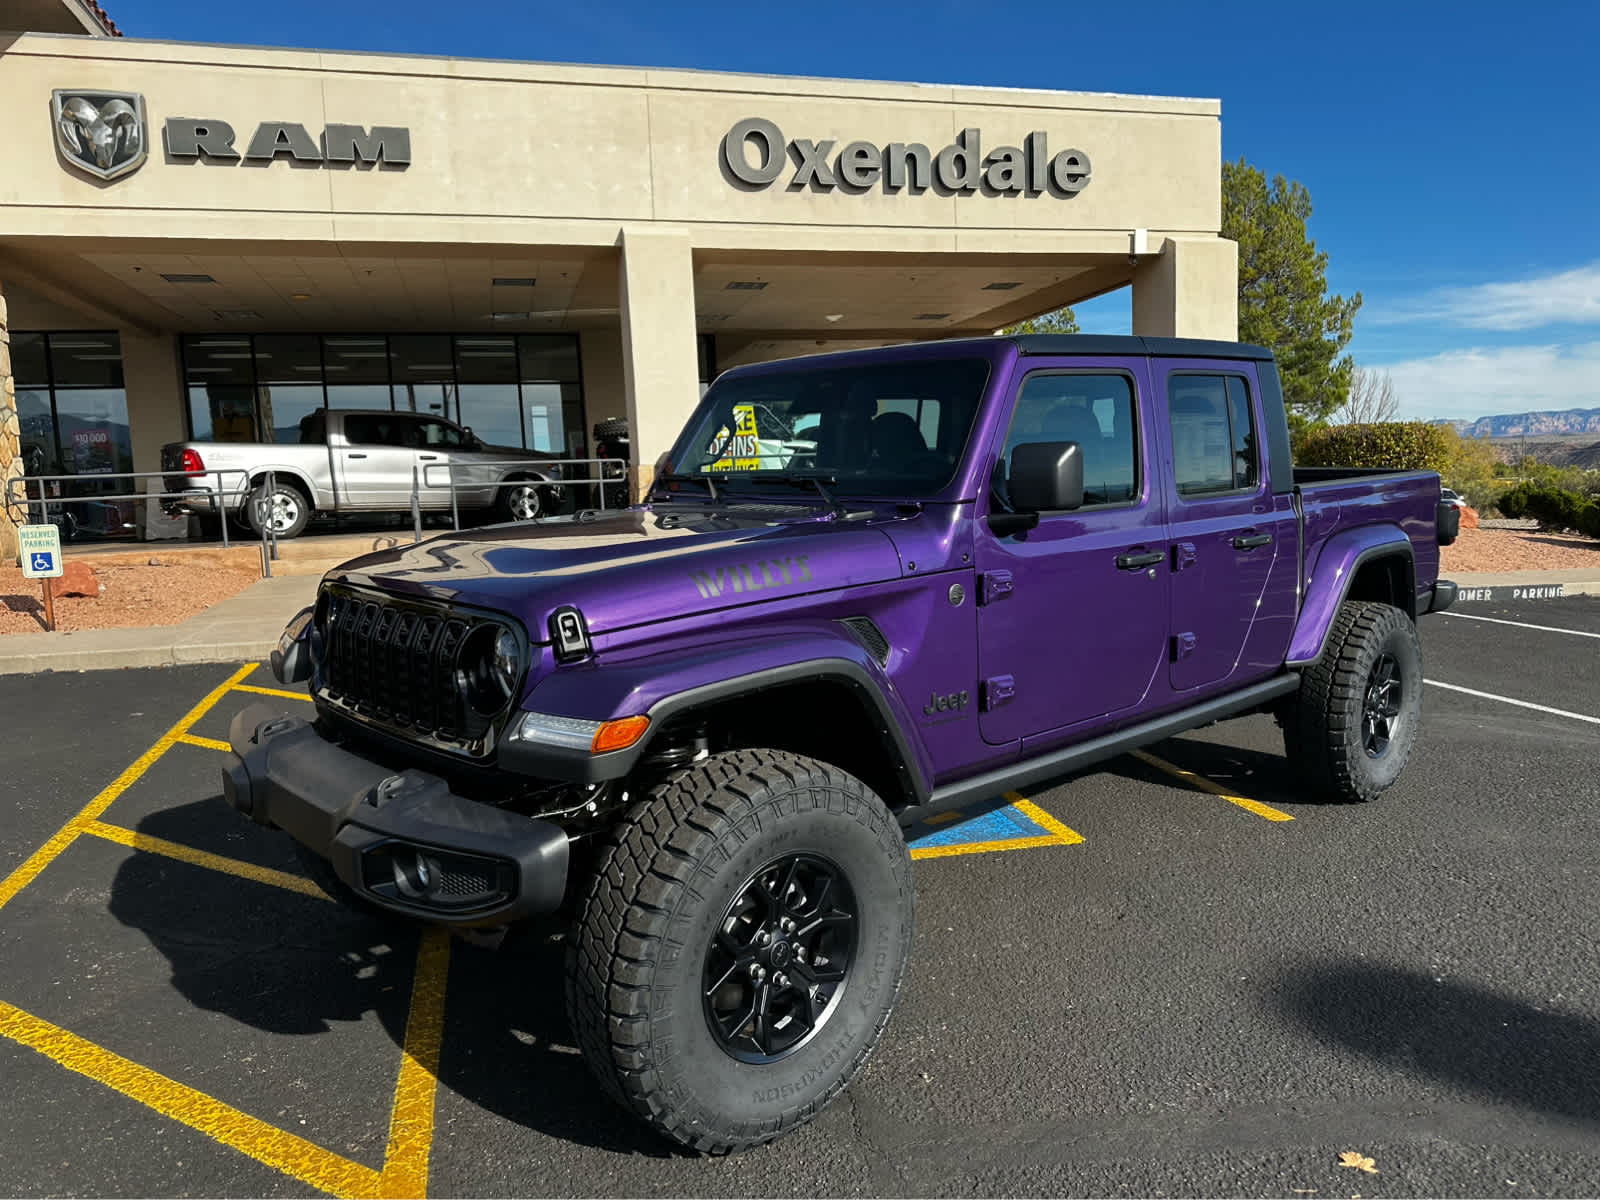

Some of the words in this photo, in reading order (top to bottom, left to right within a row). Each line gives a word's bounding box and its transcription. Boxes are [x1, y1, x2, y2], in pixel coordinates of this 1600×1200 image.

[163, 117, 411, 171] RAM
[720, 117, 1092, 197] Oxendale
[21, 530, 56, 539] RESERVED
[24, 538, 55, 548] PARKING
[688, 555, 813, 599] WILLYS
[1458, 588, 1493, 601] OMER
[1512, 586, 1564, 600] PARKING
[922, 689, 969, 716] Jeep
